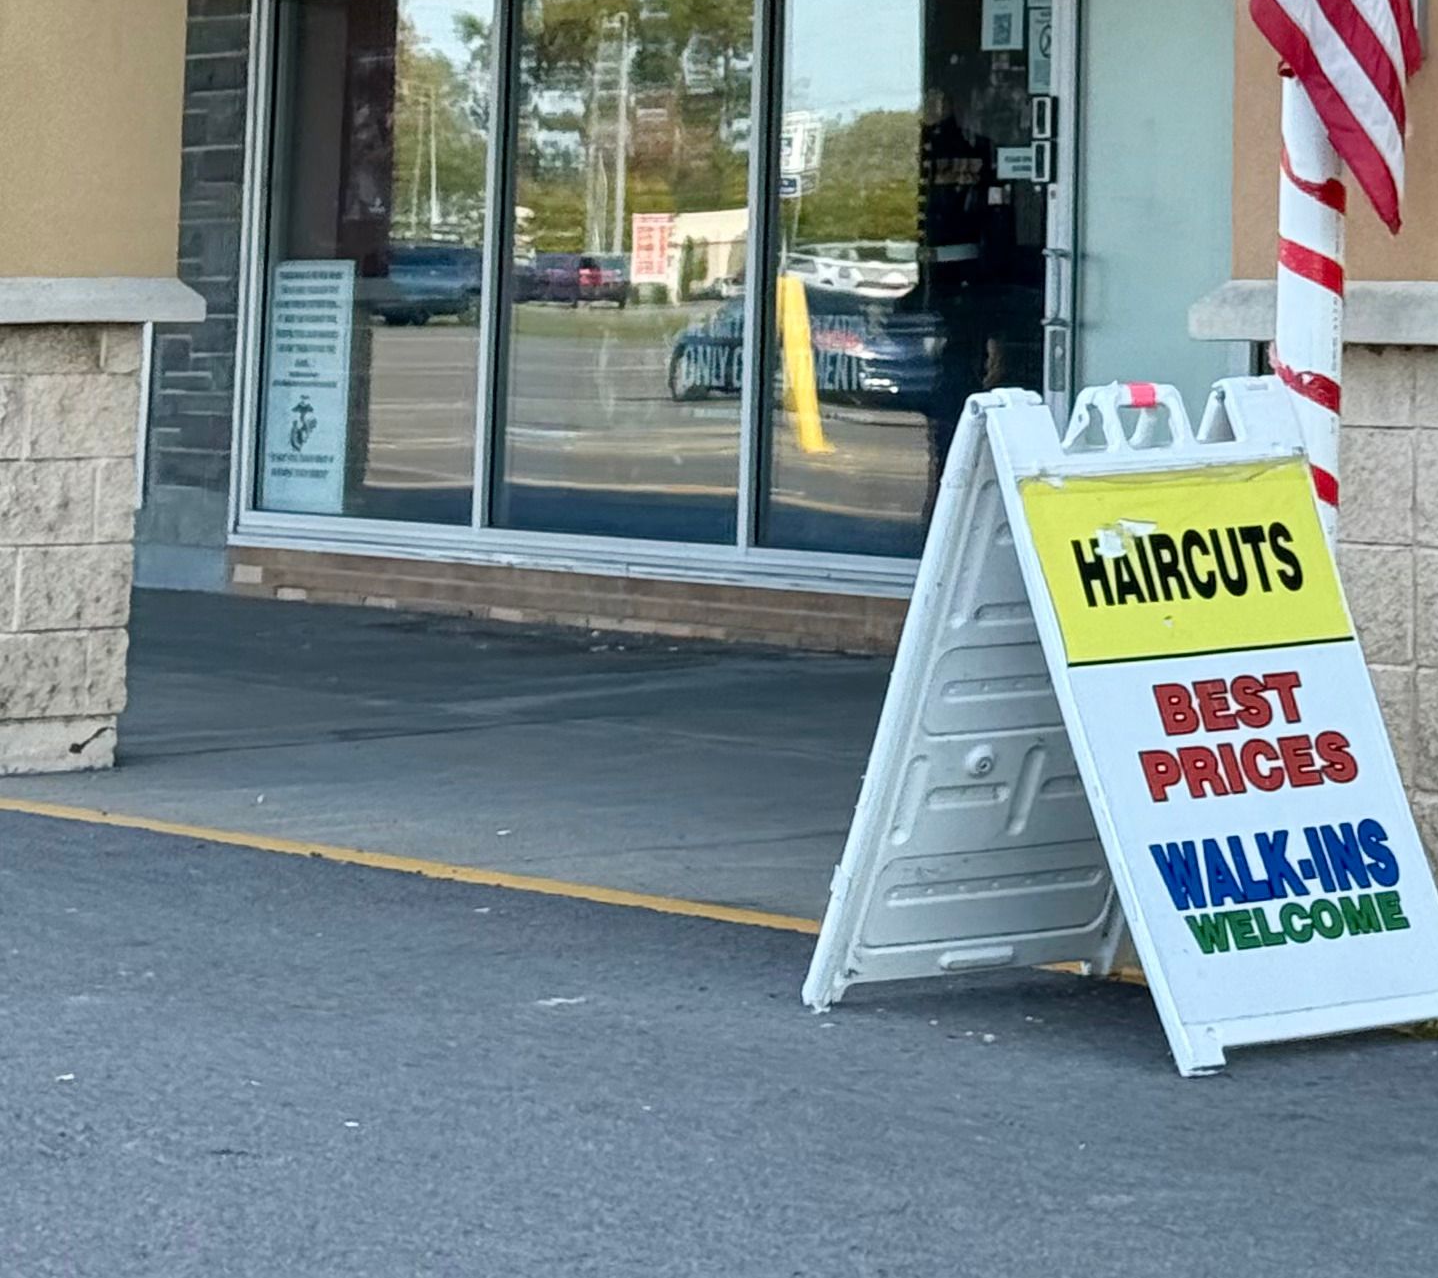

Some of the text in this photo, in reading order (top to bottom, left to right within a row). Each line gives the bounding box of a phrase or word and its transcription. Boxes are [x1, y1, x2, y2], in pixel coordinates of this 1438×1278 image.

[1070, 521, 1303, 607] HAIRCUTS
[1152, 671, 1302, 736] BEST
[1138, 730, 1359, 803] PRICES
[1149, 818, 1400, 911] WALK-INS
[1184, 890, 1411, 955] WELCOME
